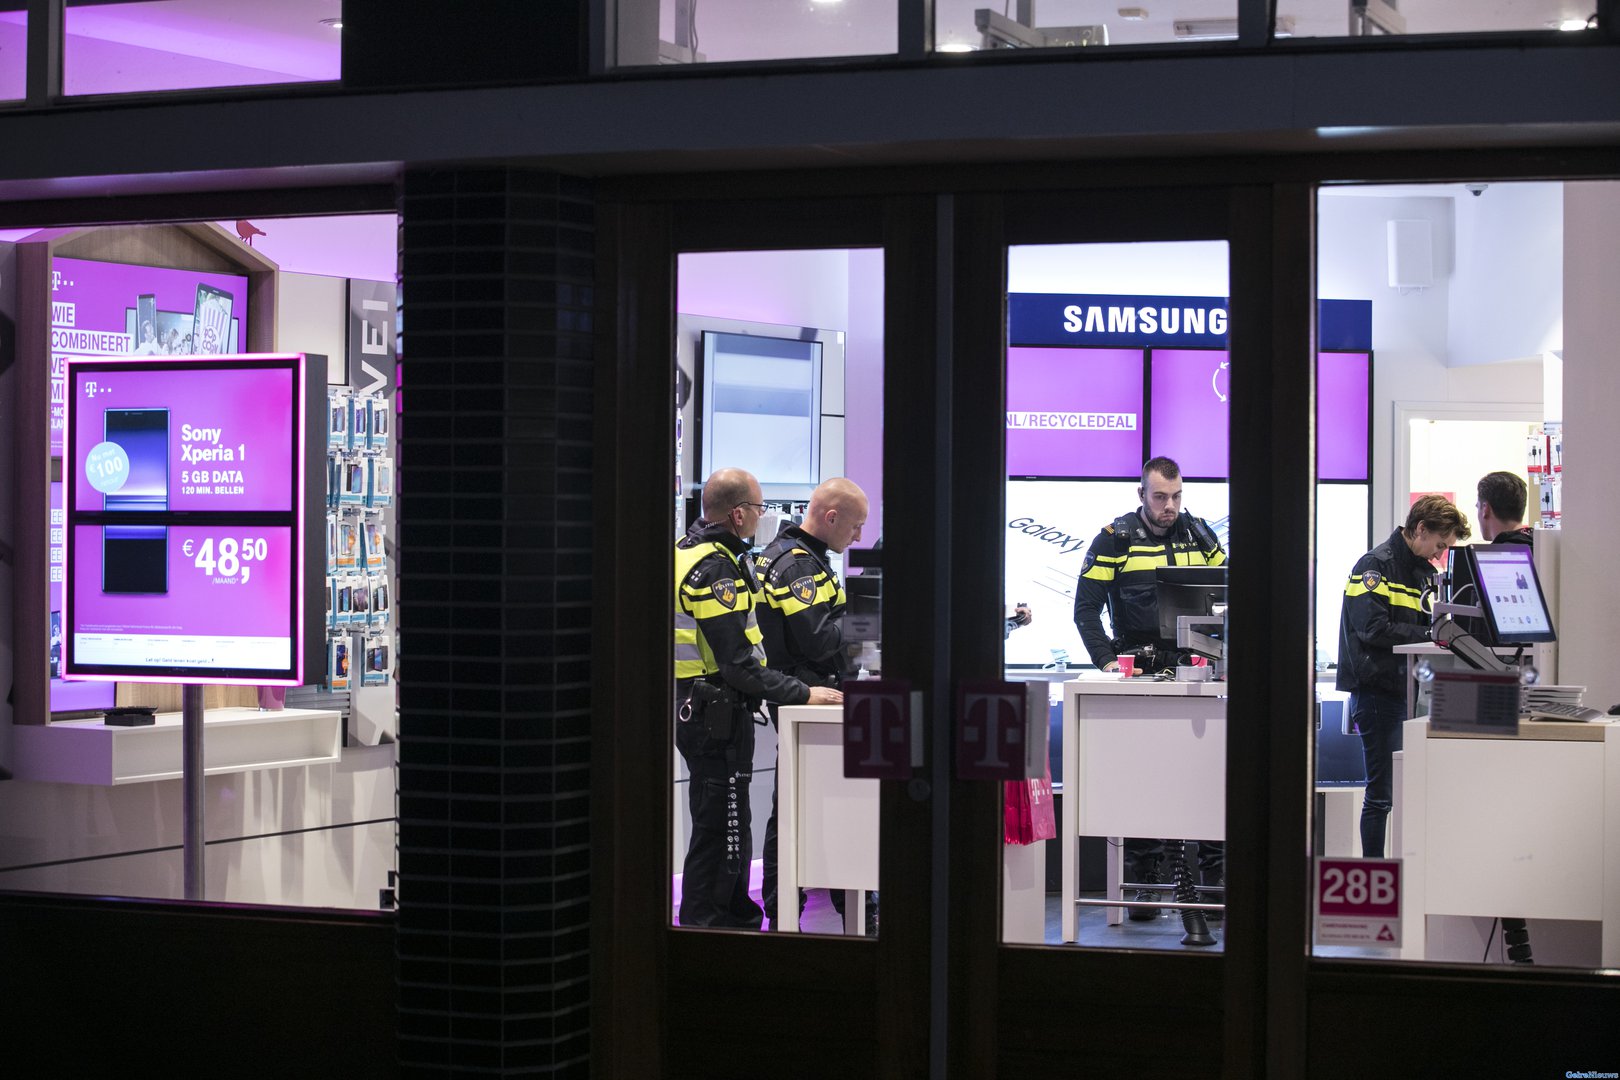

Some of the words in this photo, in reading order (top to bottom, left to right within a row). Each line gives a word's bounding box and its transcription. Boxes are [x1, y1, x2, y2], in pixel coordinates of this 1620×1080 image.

[1063, 305, 1228, 335] SAMSUNG
[52, 331, 131, 352] COMBINEERT
[181, 424, 221, 445] Sony
[181, 444, 234, 465] Xperia
[238, 444, 245, 461] 1
[182, 470, 189, 483] 5
[192, 470, 210, 483] GB
[212, 470, 244, 483] DATA
[181, 486, 195, 494] 120
[196, 486, 213, 494] MIN.
[215, 486, 244, 494] BELLEN
[1008, 517, 1085, 554] Galaxy
[1322, 867, 1395, 905] 28B
